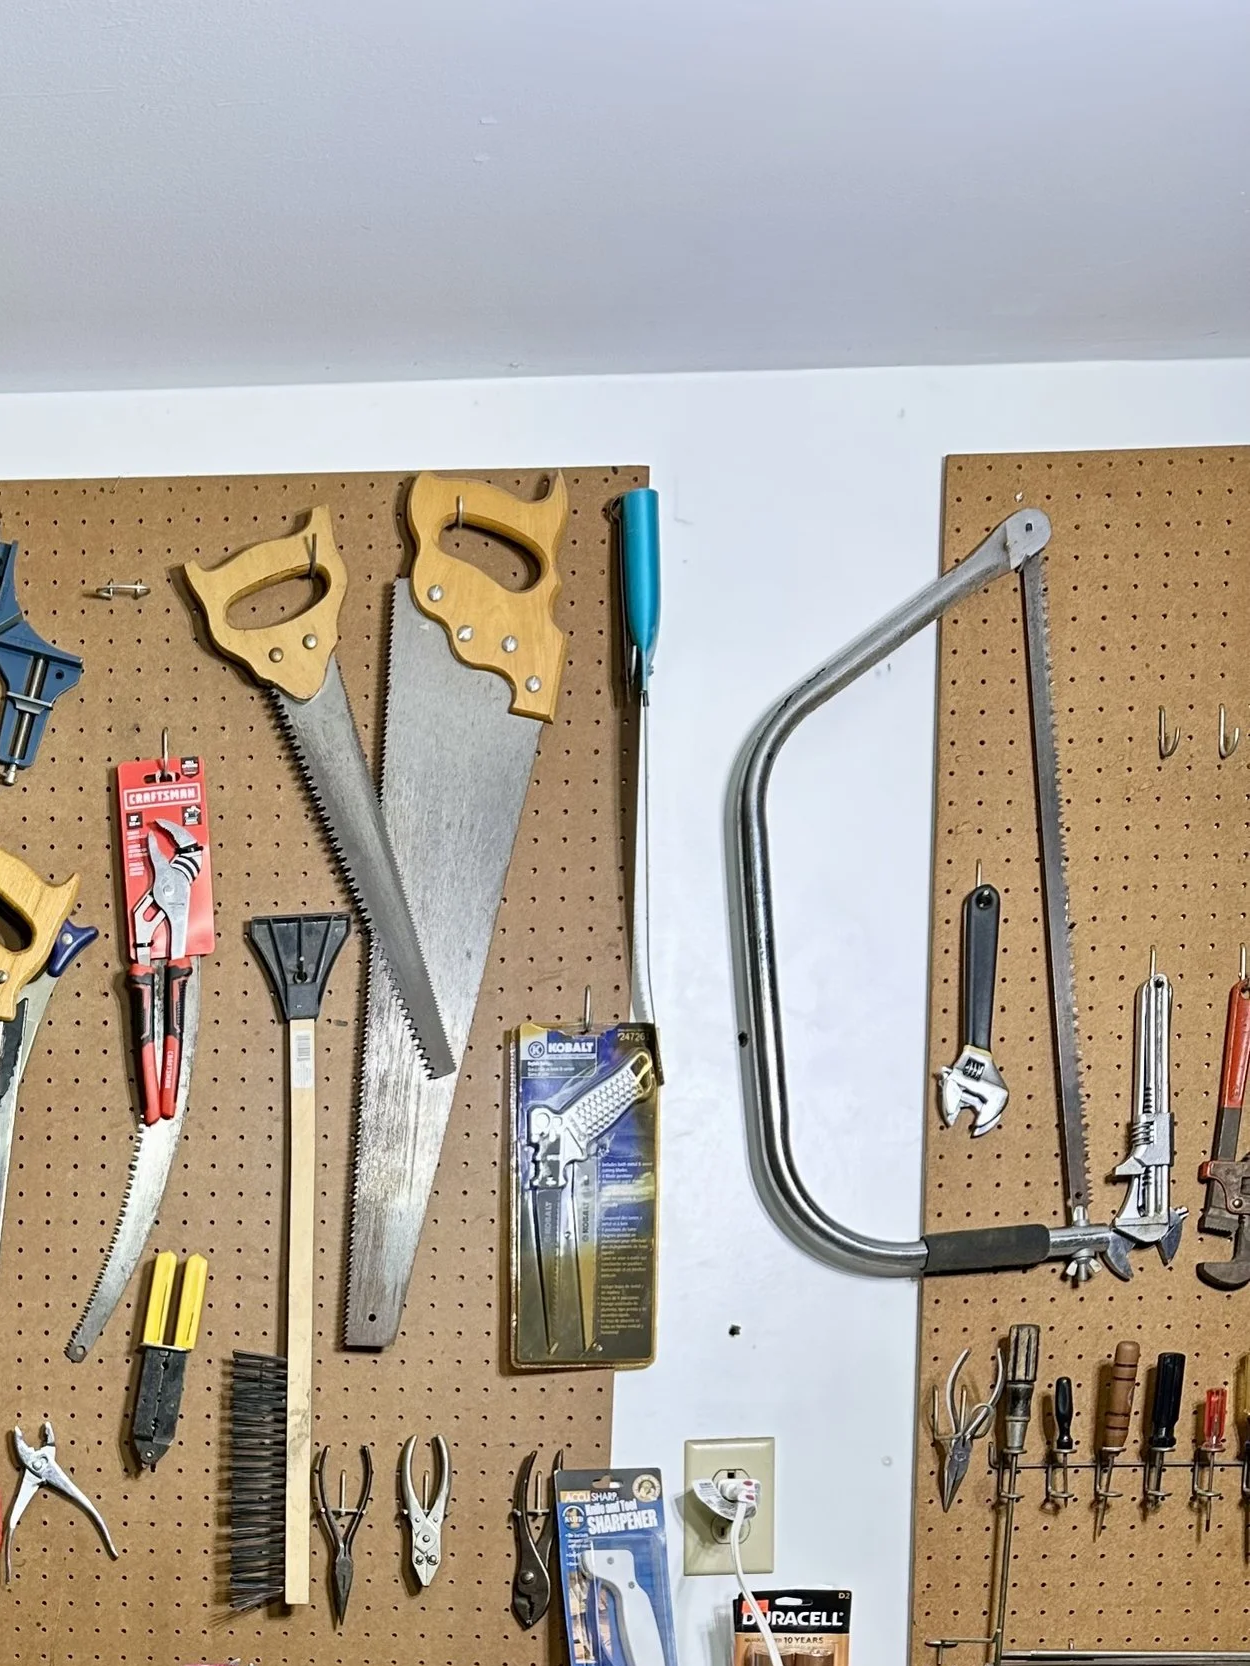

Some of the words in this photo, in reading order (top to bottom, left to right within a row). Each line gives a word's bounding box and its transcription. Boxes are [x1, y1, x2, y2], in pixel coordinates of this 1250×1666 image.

[129, 788, 196, 805] CRAFTSMAN
[548, 1043, 593, 1052] KOBALT
[164, 1049, 174, 1089] CRAFTSMAN
[620, 1499, 637, 1511] Tool
[587, 1509, 658, 1535] SHARPENER
